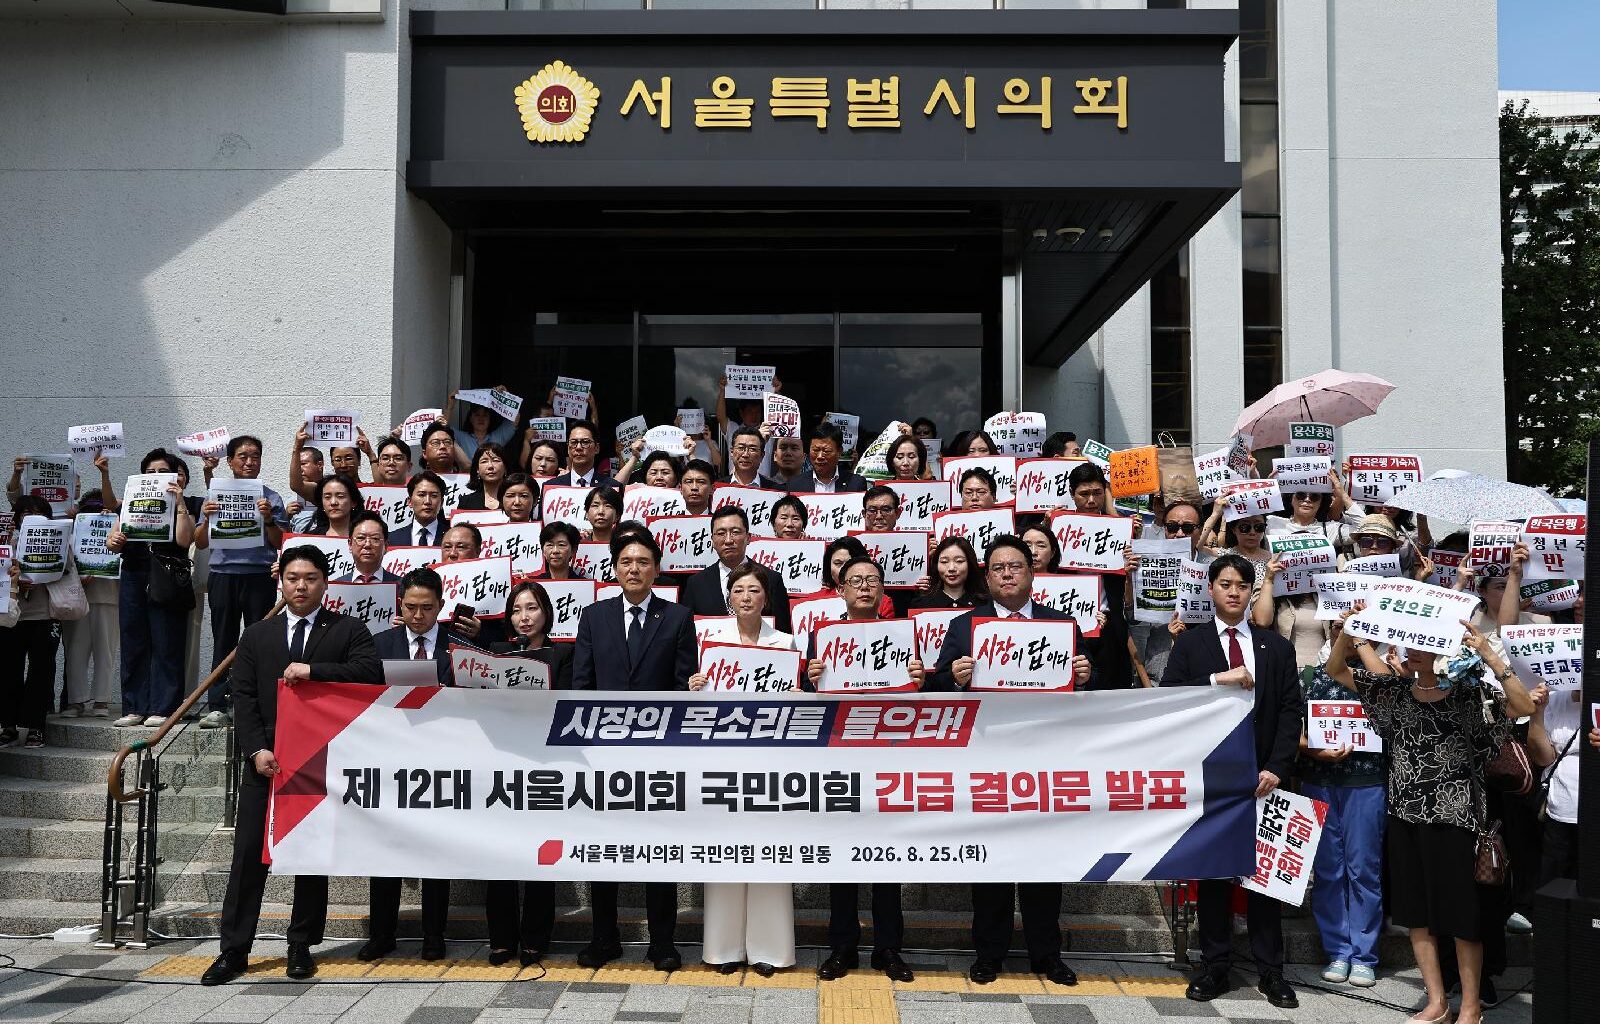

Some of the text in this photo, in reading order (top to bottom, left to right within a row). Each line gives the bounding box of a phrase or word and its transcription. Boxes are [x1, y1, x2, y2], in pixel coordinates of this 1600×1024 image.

[540, 93, 575, 113] 의회
[620, 75, 1128, 129] 서울특별시의회
[1293, 425, 1332, 439] 용산공원
[1276, 462, 1311, 473] 한국은행
[1352, 457, 1418, 468] 한국은행 기숙사
[1019, 470, 1052, 496] 시장이
[1308, 475, 1328, 486] 반대
[217, 503, 255, 512] 대한민국의
[547, 496, 581, 519] 시장이
[626, 496, 660, 519] 시장이
[831, 503, 863, 530] 답이다
[916, 492, 949, 520] 답이다
[1233, 497, 1270, 515] 반대
[1530, 517, 1577, 530] 한국은행
[26, 538, 62, 546] 대한민국의
[506, 534, 541, 561] 답이다
[1056, 523, 1127, 556] 시장이 답이다
[1473, 534, 1519, 547] 임대주택
[787, 551, 822, 580] 답이다
[891, 544, 926, 574] 답이다
[1140, 557, 1182, 569] 용산공원은
[1310, 553, 1331, 564] 마라
[472, 570, 510, 602] 답이다
[1318, 581, 1357, 593] 한국은행
[356, 595, 394, 624] 답이다
[1059, 588, 1096, 618] 답이다
[1378, 596, 1443, 620] 공원으로!
[1351, 619, 1454, 650] 주택은 정비사업으로!
[821, 634, 914, 673] 시장이 답이다
[976, 633, 1070, 672] 시장이 답이다
[1510, 641, 1556, 658] 우선착공
[457, 657, 546, 688] 시장이 답이다
[705, 657, 795, 692] 시장이 답이다
[559, 705, 963, 742] 시장의 목소리를 들으라!
[1323, 730, 1367, 748] 반대
[342, 767, 1188, 813] 제 12대 서울시의회 국민의힘 긴급 결의문 발표
[1257, 792, 1291, 844] 목소리를
[568, 844, 988, 865] 서울특별시의회 국민의힘 의원 일동 2026. 8. 25.(화)
[1275, 844, 1306, 886] 시장의
